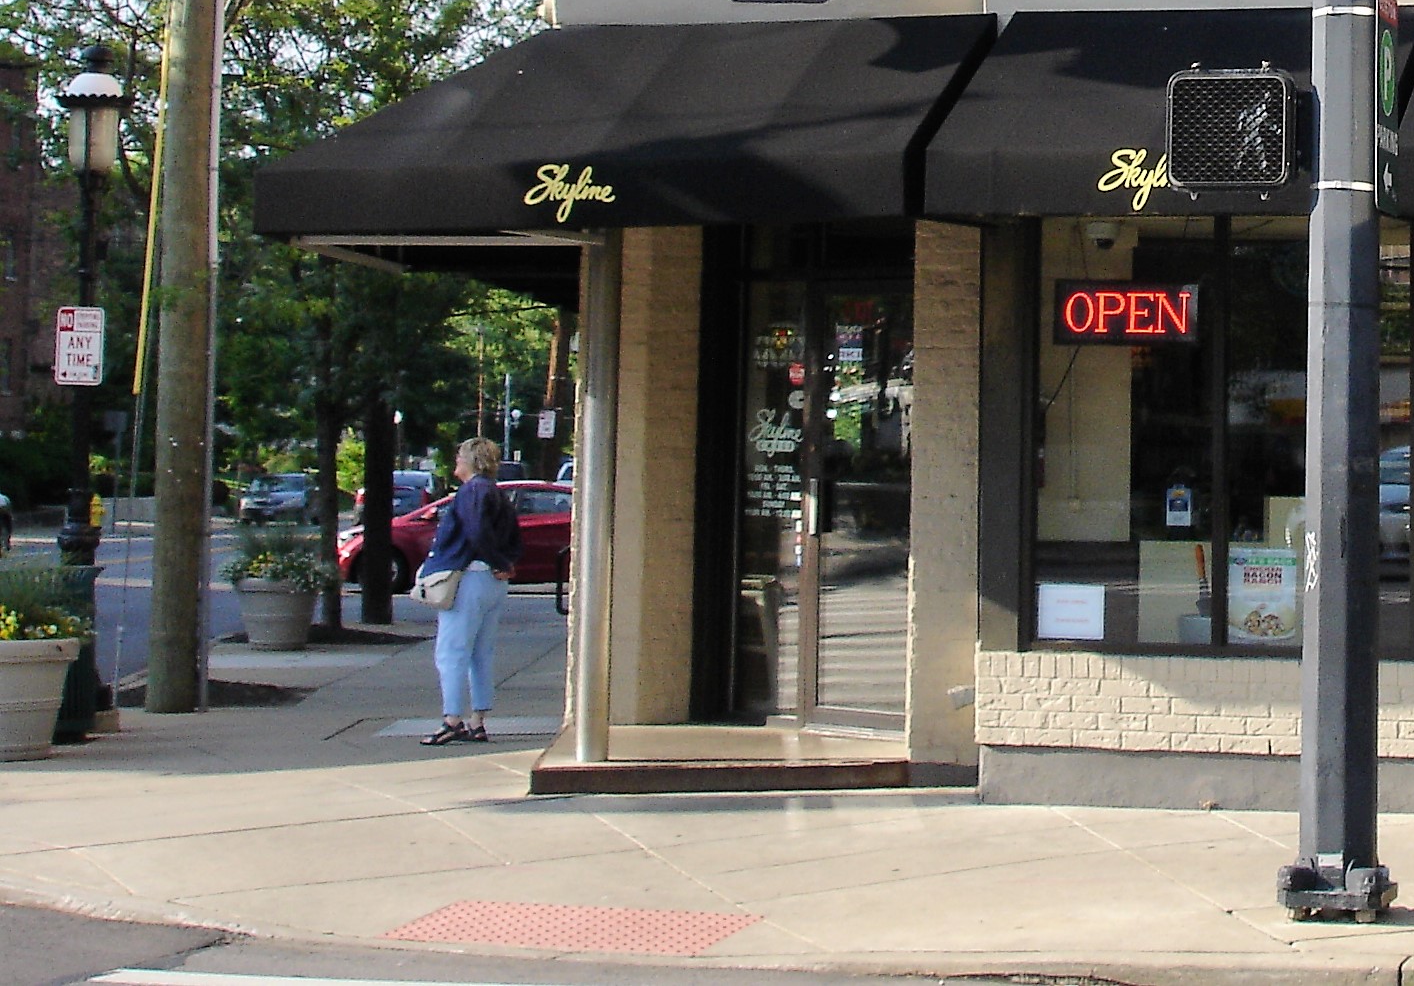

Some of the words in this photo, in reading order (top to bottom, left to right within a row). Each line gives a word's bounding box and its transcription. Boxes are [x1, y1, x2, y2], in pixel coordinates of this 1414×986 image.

[524, 164, 616, 223] Skyline
[1064, 291, 1191, 334] OPEN
[67, 336, 92, 350] ANY
[66, 354, 93, 367] TIME
